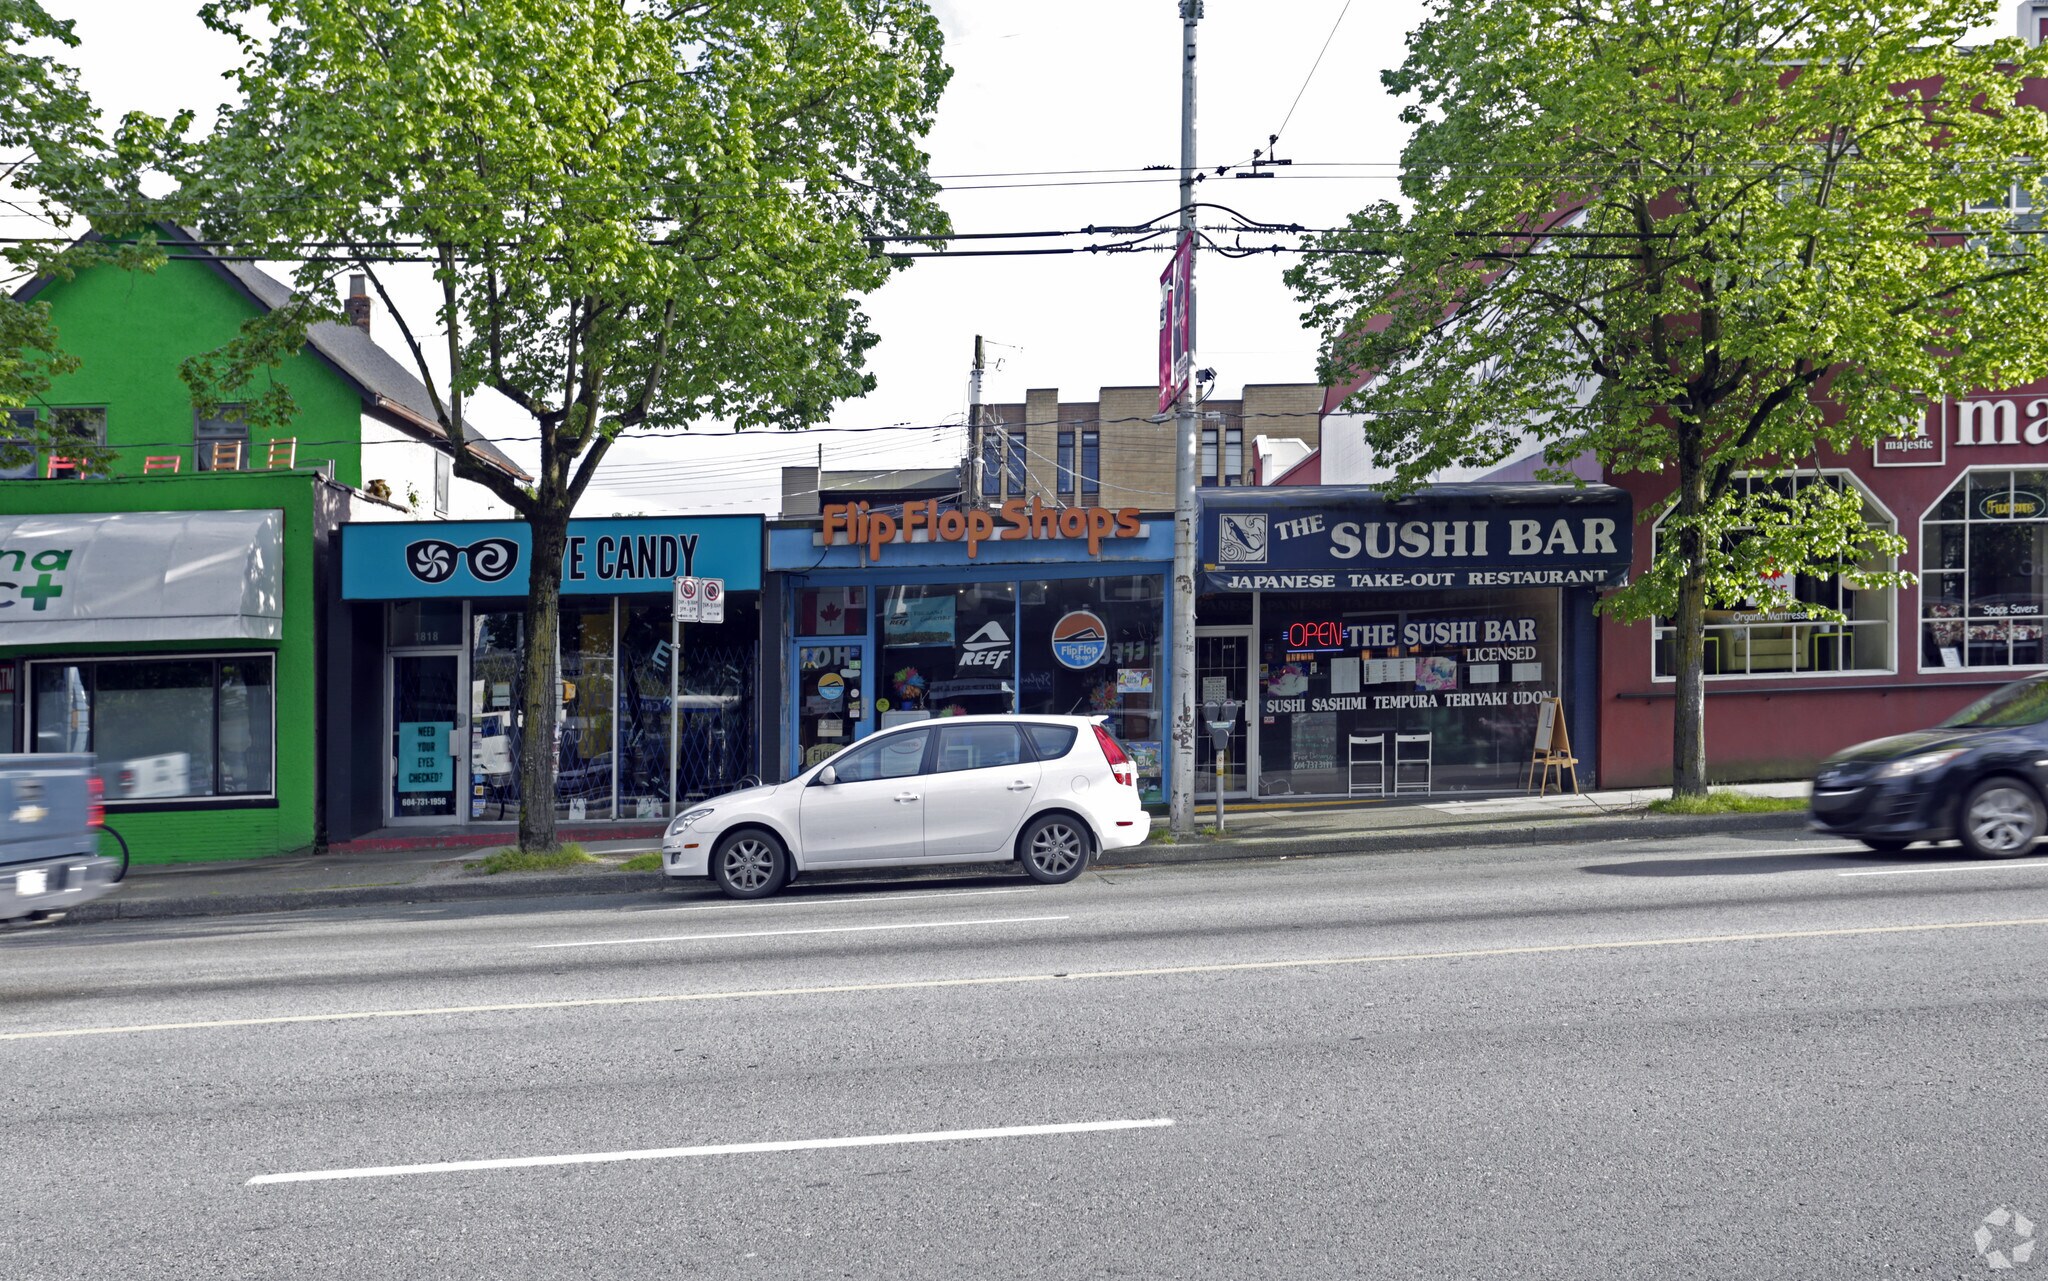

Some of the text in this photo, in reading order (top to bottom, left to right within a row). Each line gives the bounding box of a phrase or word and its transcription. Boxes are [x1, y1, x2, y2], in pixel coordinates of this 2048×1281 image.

[1885, 438, 1934, 452] majestic
[822, 495, 1141, 562] Flip Flop Shops
[1274, 514, 1618, 559] THE SUSHI BAR
[596, 534, 699, 580] CANDY
[1227, 569, 1609, 589] JAPANESE TAKE-OUT RESTAURANT
[1733, 612, 1765, 623] Organic
[1983, 604, 2038, 617] Space Savers
[414, 631, 439, 642] 1818
[1289, 619, 1537, 648] OPEN THE SUSHI BAR
[1061, 645, 1077, 660] Flip
[1078, 645, 1098, 658] Flop
[1466, 646, 1537, 662] LICENSED
[958, 650, 1011, 670] REEF
[1266, 690, 1552, 713] SUSHI SASHIMI TEMPURA TERIYAKI UDON
[417, 726, 436, 737] NEED
[417, 741, 436, 752] YOUR
[417, 757, 435, 767] EYES
[408, 772, 443, 783] CHECKED?
[402, 797, 447, 807] 604-731-1956
